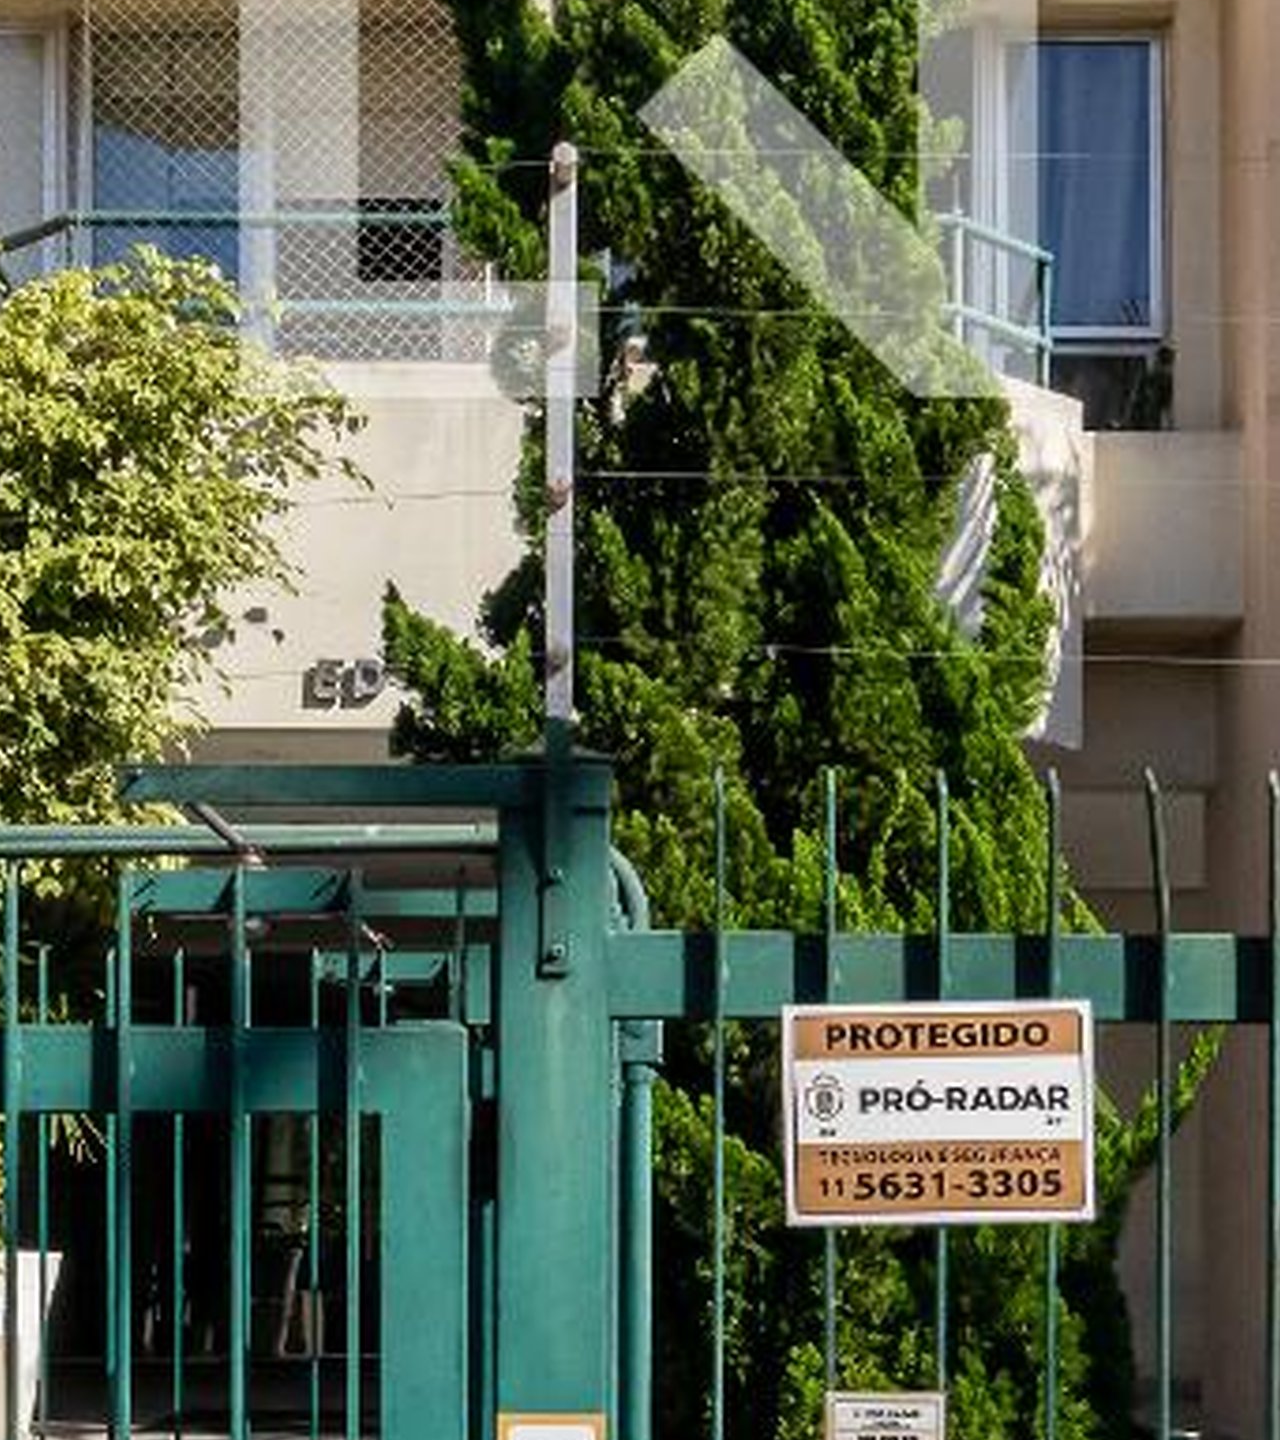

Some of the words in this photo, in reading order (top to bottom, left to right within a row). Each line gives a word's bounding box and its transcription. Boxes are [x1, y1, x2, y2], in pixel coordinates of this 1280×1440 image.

[825, 1021, 1050, 1051] PROTEGIDO
[858, 1079, 1070, 1113] PRÓ-RADAR
[819, 1178, 845, 1197] 11
[853, 1168, 1062, 1201] 5631-3305
